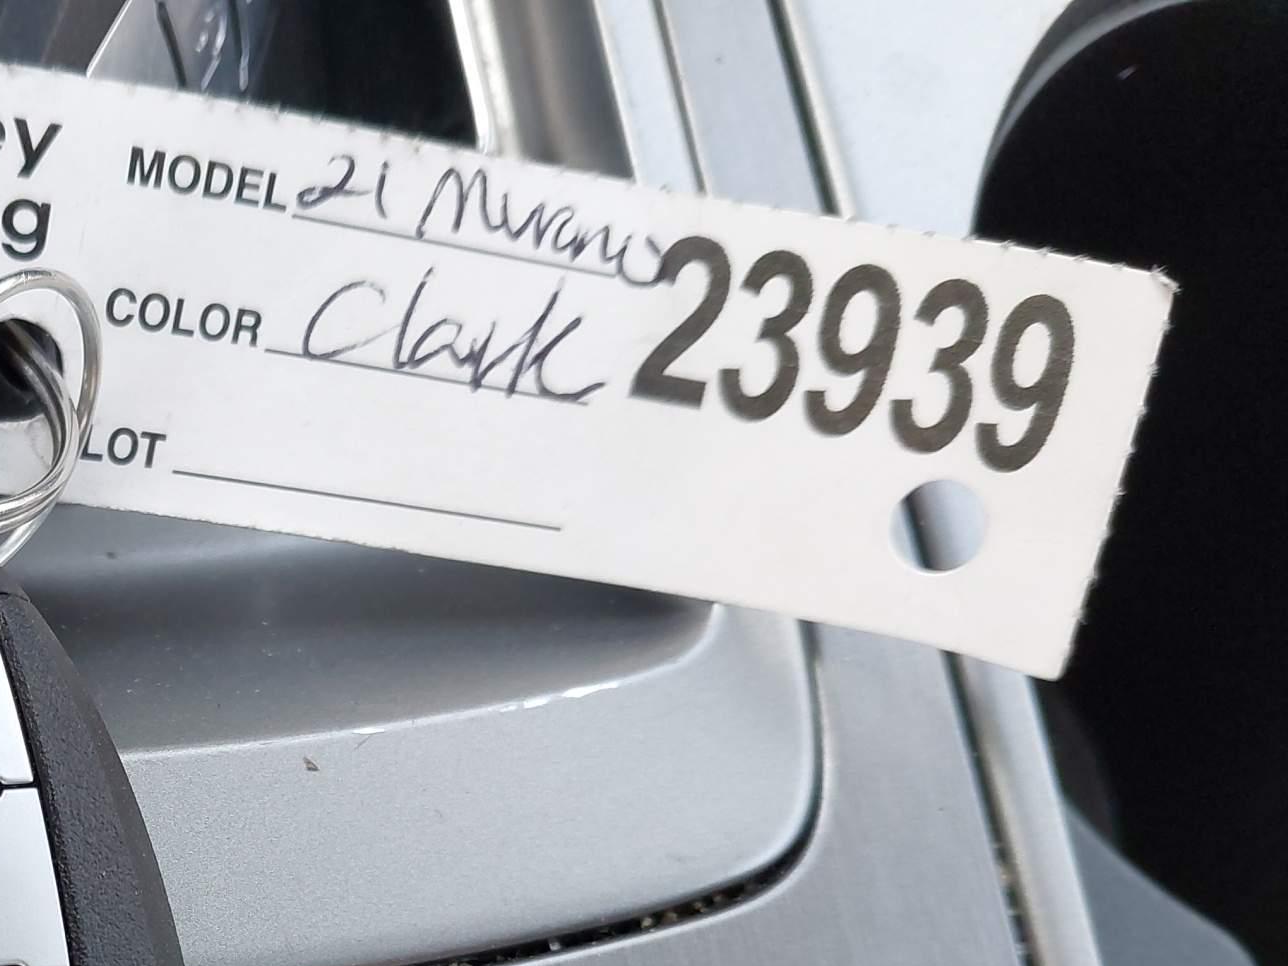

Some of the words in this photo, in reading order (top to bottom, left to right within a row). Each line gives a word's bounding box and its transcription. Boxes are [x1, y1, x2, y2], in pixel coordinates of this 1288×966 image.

[126, 146, 289, 214] MODEL
[296, 154, 390, 219] 21
[105, 287, 263, 348] COLOR
[628, 235, 1077, 473] 23939
[78, 425, 167, 469] LOT
